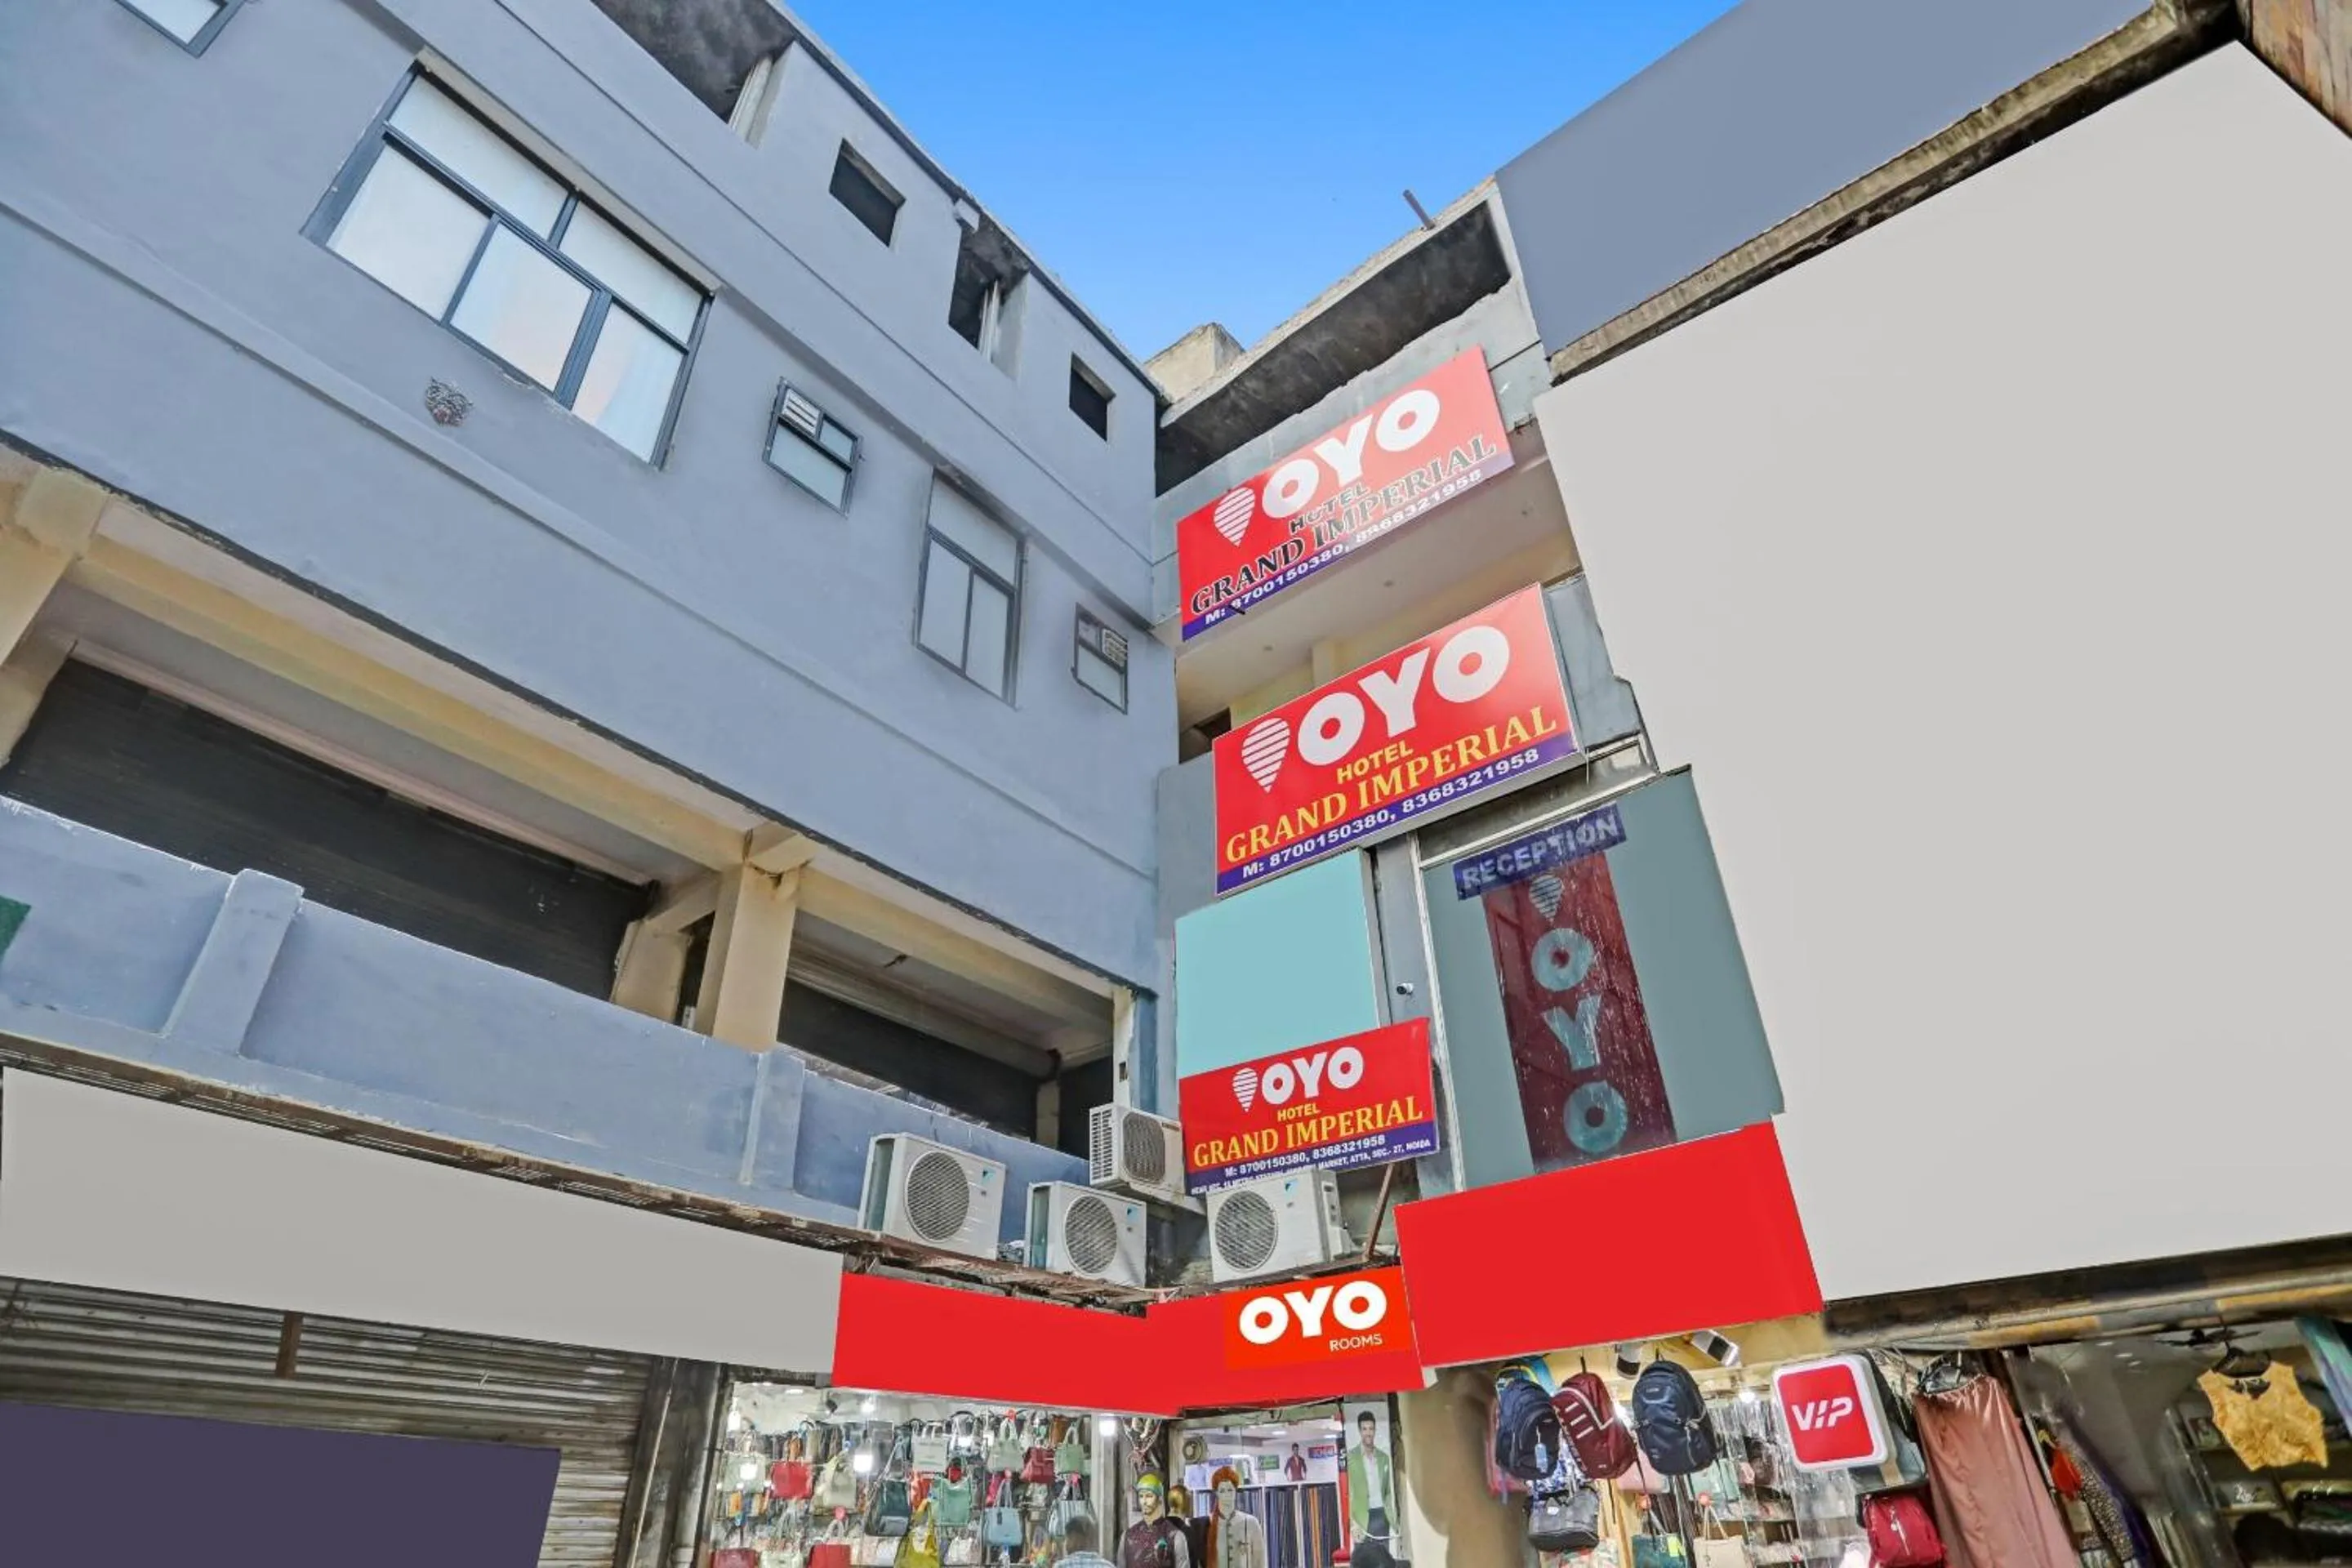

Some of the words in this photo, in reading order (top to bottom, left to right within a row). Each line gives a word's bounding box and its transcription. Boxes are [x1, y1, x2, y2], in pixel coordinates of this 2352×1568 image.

[1262, 389, 1441, 519] OYO
[1191, 537, 1305, 615] GRAND
[1311, 434, 1497, 550] IMPERIAL
[1290, 481, 1370, 535] HOTEL
[1205, 608, 1225, 625] M:
[1297, 625, 1510, 766] OYO
[1227, 791, 1348, 863] GRAND
[1359, 705, 1557, 809] IMPERIAL
[1337, 737, 1414, 785] HOTEL
[1242, 861, 1264, 879] M:
[1269, 809, 1396, 866] 8700150380,
[1402, 747, 1539, 813] 8368321958
[1461, 815, 1619, 890] RECEPTION
[1530, 927, 1628, 1154] OYO
[1261, 1046, 1364, 1105] OYO
[1193, 1128, 1280, 1168] GRAND
[1286, 1095, 1423, 1148] IMPERIAL
[1276, 1102, 1321, 1122] HOTEL
[1224, 1166, 1238, 1178] M:
[1239, 1152, 1310, 1174] 8700150380,
[1312, 1134, 1386, 1160] 8368321958
[1350, 1152, 1371, 1164] ATTA,
[1239, 1280, 1388, 1345] OYO
[1329, 1334, 1383, 1352] ROOMS
[1791, 1396, 1856, 1432] VIP
